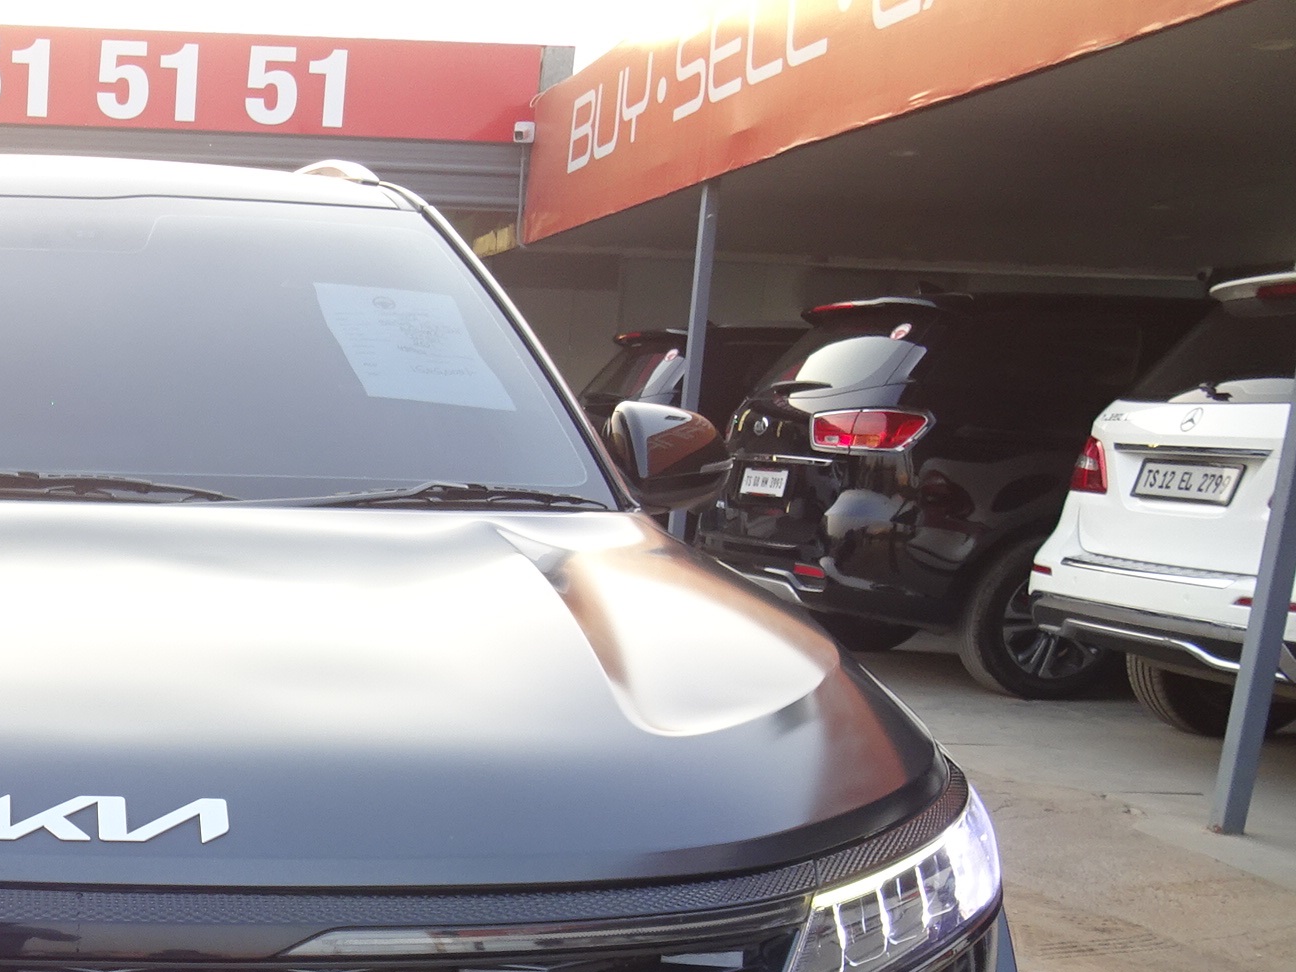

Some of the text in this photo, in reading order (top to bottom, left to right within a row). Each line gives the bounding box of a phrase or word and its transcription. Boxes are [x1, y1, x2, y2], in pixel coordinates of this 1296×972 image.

[96, 39, 200, 122] 51
[244, 45, 349, 128] 51
[1143, 469, 1232, 494] TS 12 EL 2799
